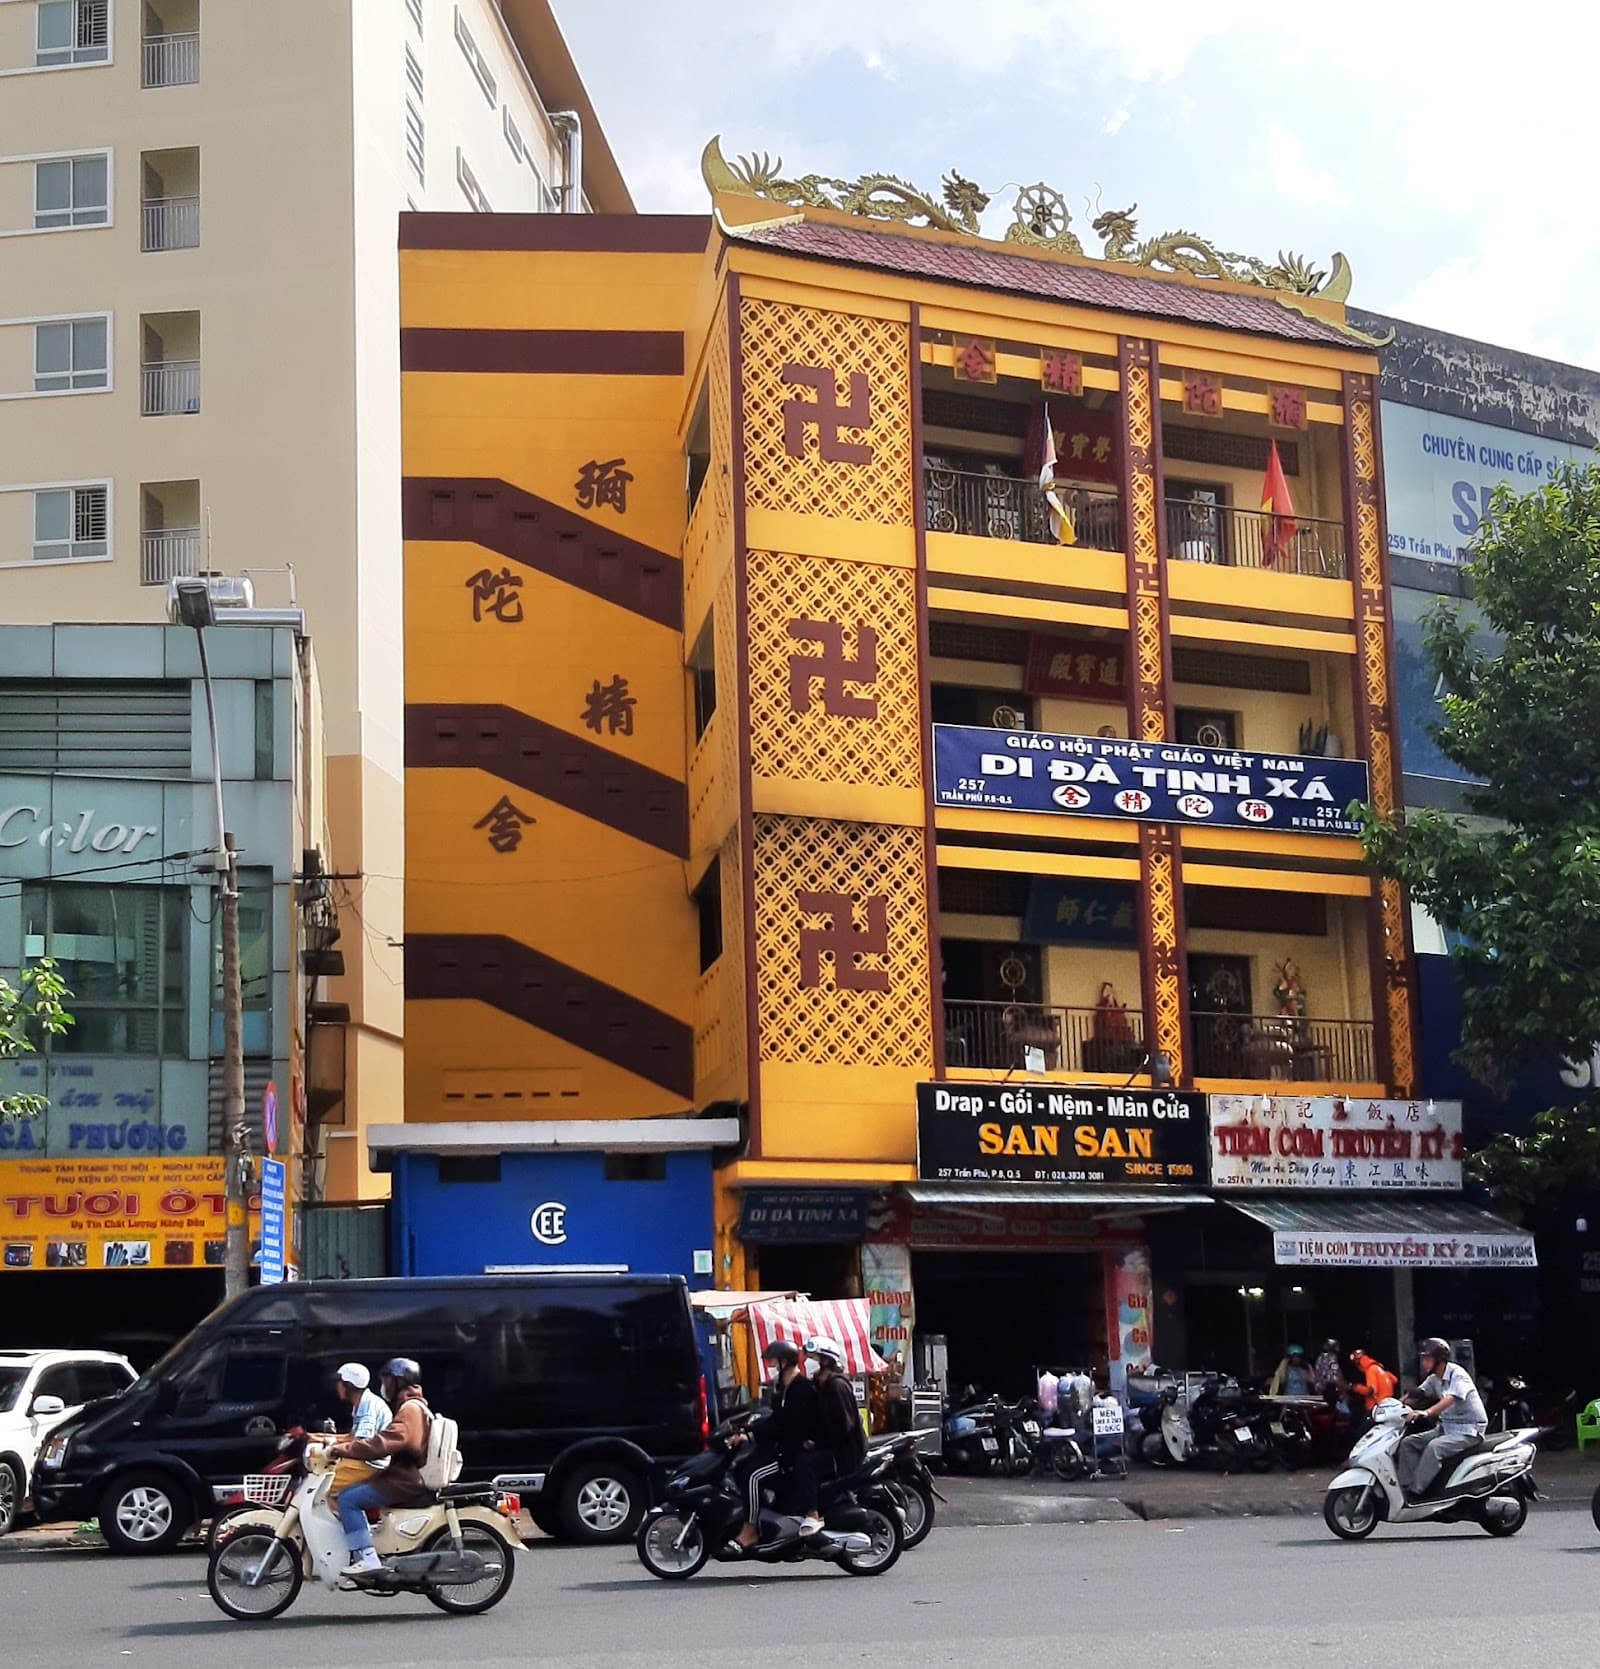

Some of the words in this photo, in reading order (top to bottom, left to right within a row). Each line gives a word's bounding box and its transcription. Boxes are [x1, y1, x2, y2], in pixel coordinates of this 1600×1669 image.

[1422, 433, 1475, 463] CHUYÊN
[1479, 446, 1514, 471] CUNG
[1518, 450, 1542, 477] CẤP
[1388, 534, 1406, 550] 259
[1006, 735, 1054, 751] GIÁO
[1060, 739, 1092, 756] HỘI
[1101, 742, 1154, 760] PHẬT
[1161, 745, 1205, 764] GIÁO
[1212, 750, 1254, 769] VIỆT
[1262, 757, 1304, 772] NAM
[958, 778, 986, 791] 257
[980, 753, 1034, 778] DI
[1048, 757, 1121, 785] ĐÀ
[1132, 765, 1250, 796] TỊNH
[1265, 774, 1335, 802] XÁ
[1316, 806, 1341, 819] 257
[0, 806, 157, 854] Color
[935, 1090, 983, 1116] Drap
[1000, 1088, 1033, 1114] Gối
[1048, 1094, 1093, 1120] Nệm
[1107, 1095, 1148, 1119] Màn
[1152, 1093, 1190, 1120] Cửa
[69, 1118, 187, 1151] PHƯƠNG
[978, 1122, 1060, 1157] SAN
[1074, 1124, 1153, 1158] SAN
[1213, 1118, 1272, 1161] TIỆM
[1277, 1123, 1325, 1157] CƠM
[1329, 1114, 1412, 1159] TRUYỀN
[1417, 1123, 1446, 1160] KÝ
[78, 1174, 101, 1184] KIỆN
[185, 1174, 204, 1182] CAO
[938, 1168, 952, 1177] 257
[1124, 1162, 1163, 1176] SINCE
[1227, 1176, 1245, 1185] 257A
[4, 1188, 140, 1217] TƯƠI
[1298, 1238, 1323, 1256] TIỆM
[1326, 1239, 1348, 1256] CƠM
[1350, 1237, 1429, 1258] TRUYỀN
[1432, 1238, 1460, 1258] KÝ
[1463, 1243, 1475, 1258] 2
